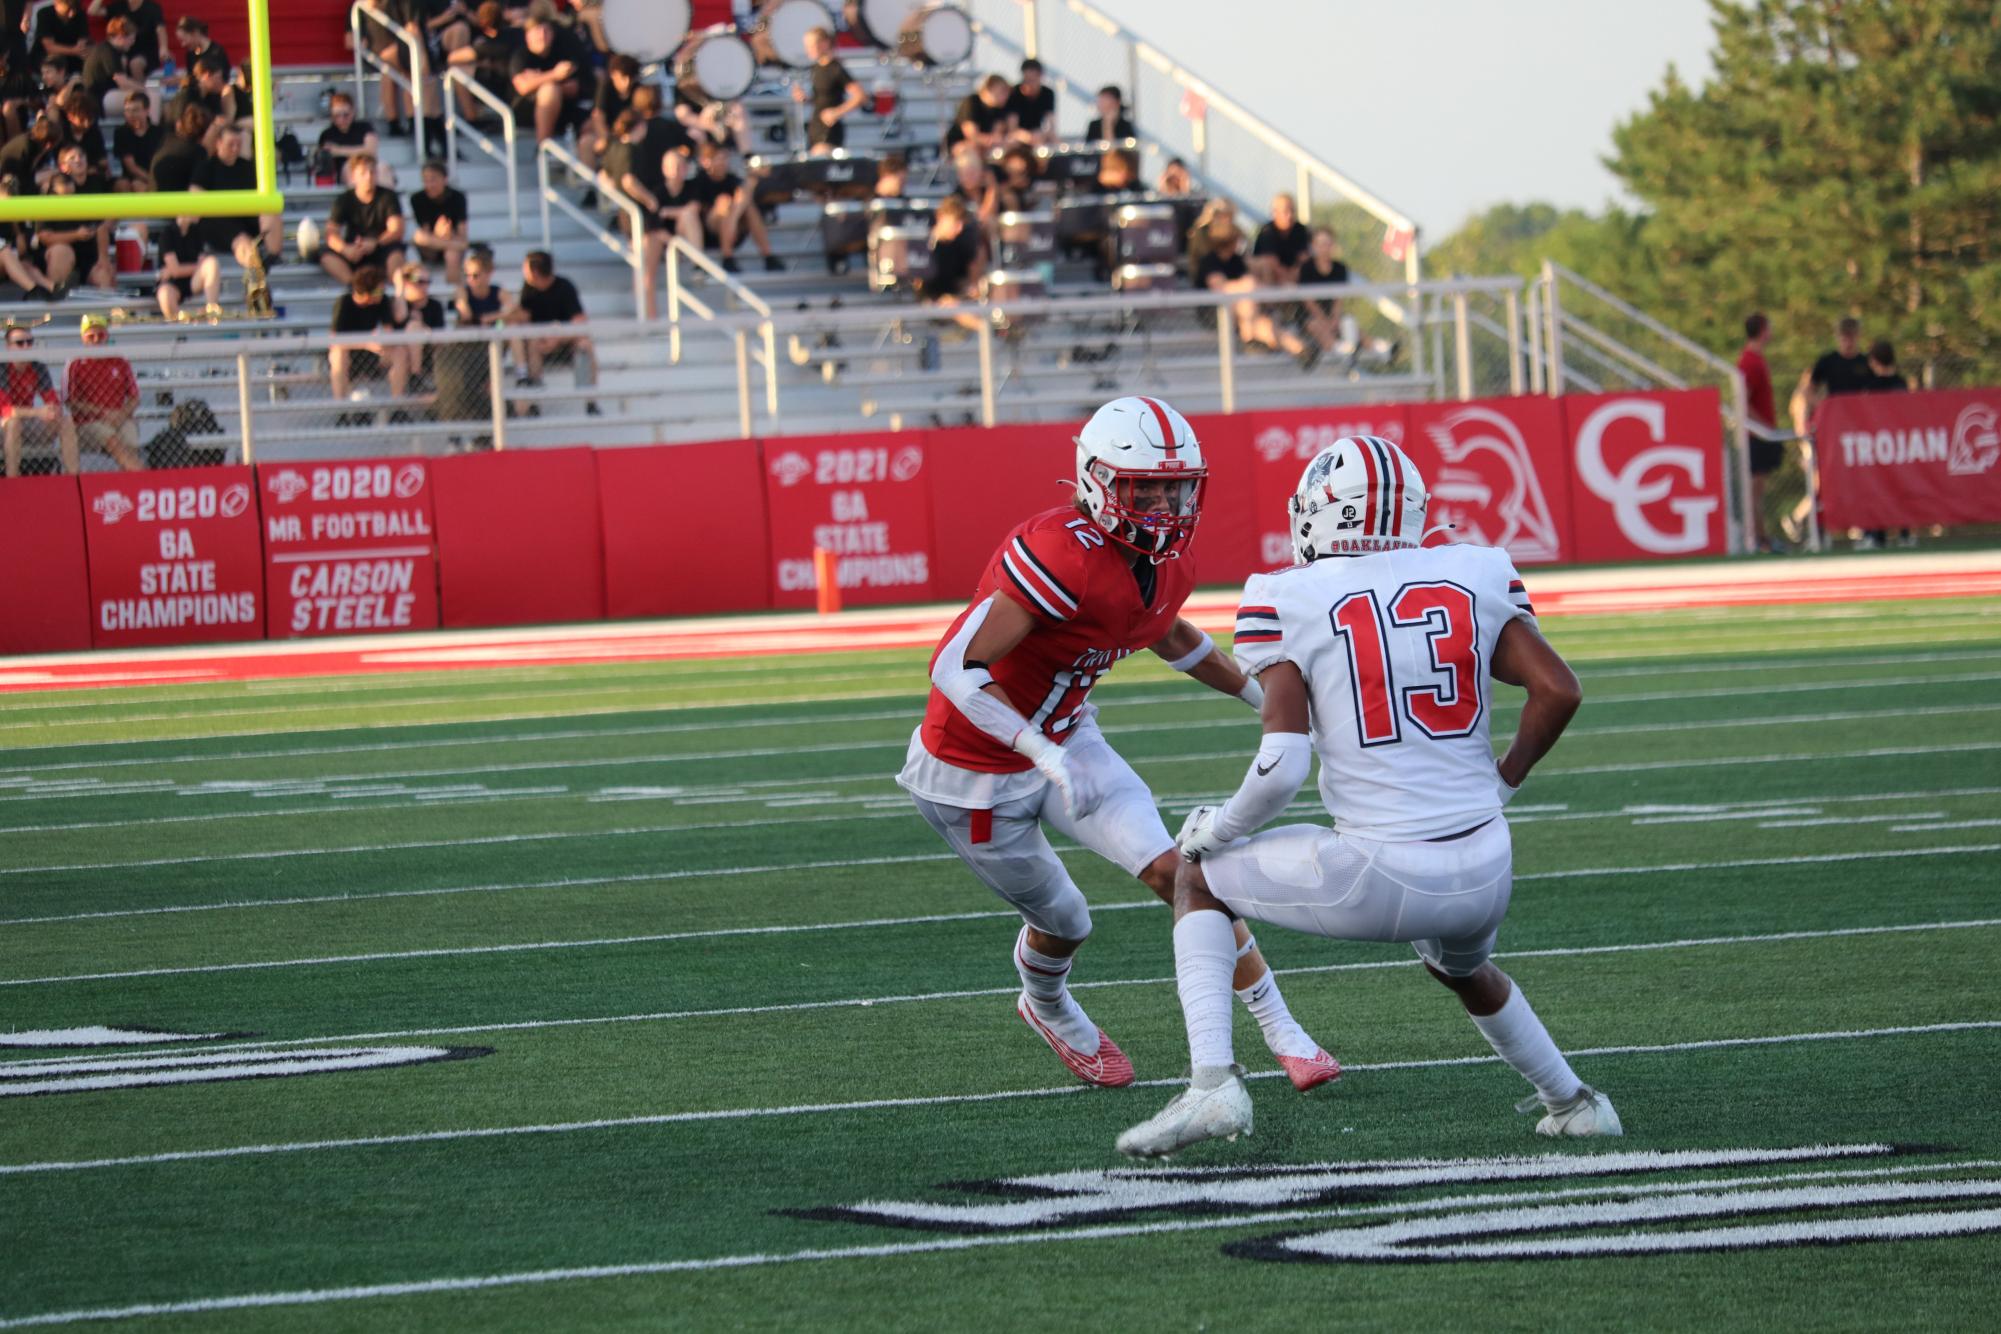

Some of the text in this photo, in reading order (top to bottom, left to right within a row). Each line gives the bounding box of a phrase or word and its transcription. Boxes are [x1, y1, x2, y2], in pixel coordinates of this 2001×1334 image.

[815, 446, 889, 485] 2021
[1840, 427, 1948, 468] TROJAN
[312, 465, 392, 500] 2020
[1575, 399, 1717, 554] CG
[137, 485, 217, 522] 2020
[312, 508, 431, 540] FOOTBALL
[814, 521, 890, 555] STATE
[1065, 517, 1105, 550] 12
[159, 527, 196, 560] 6A
[140, 560, 217, 595] STATE
[289, 560, 414, 598] CARSON
[777, 551, 929, 591] CHMPIONS
[101, 592, 256, 631] CHAMPIONS
[290, 593, 415, 631] STEELE
[1329, 579, 1484, 749] 13
